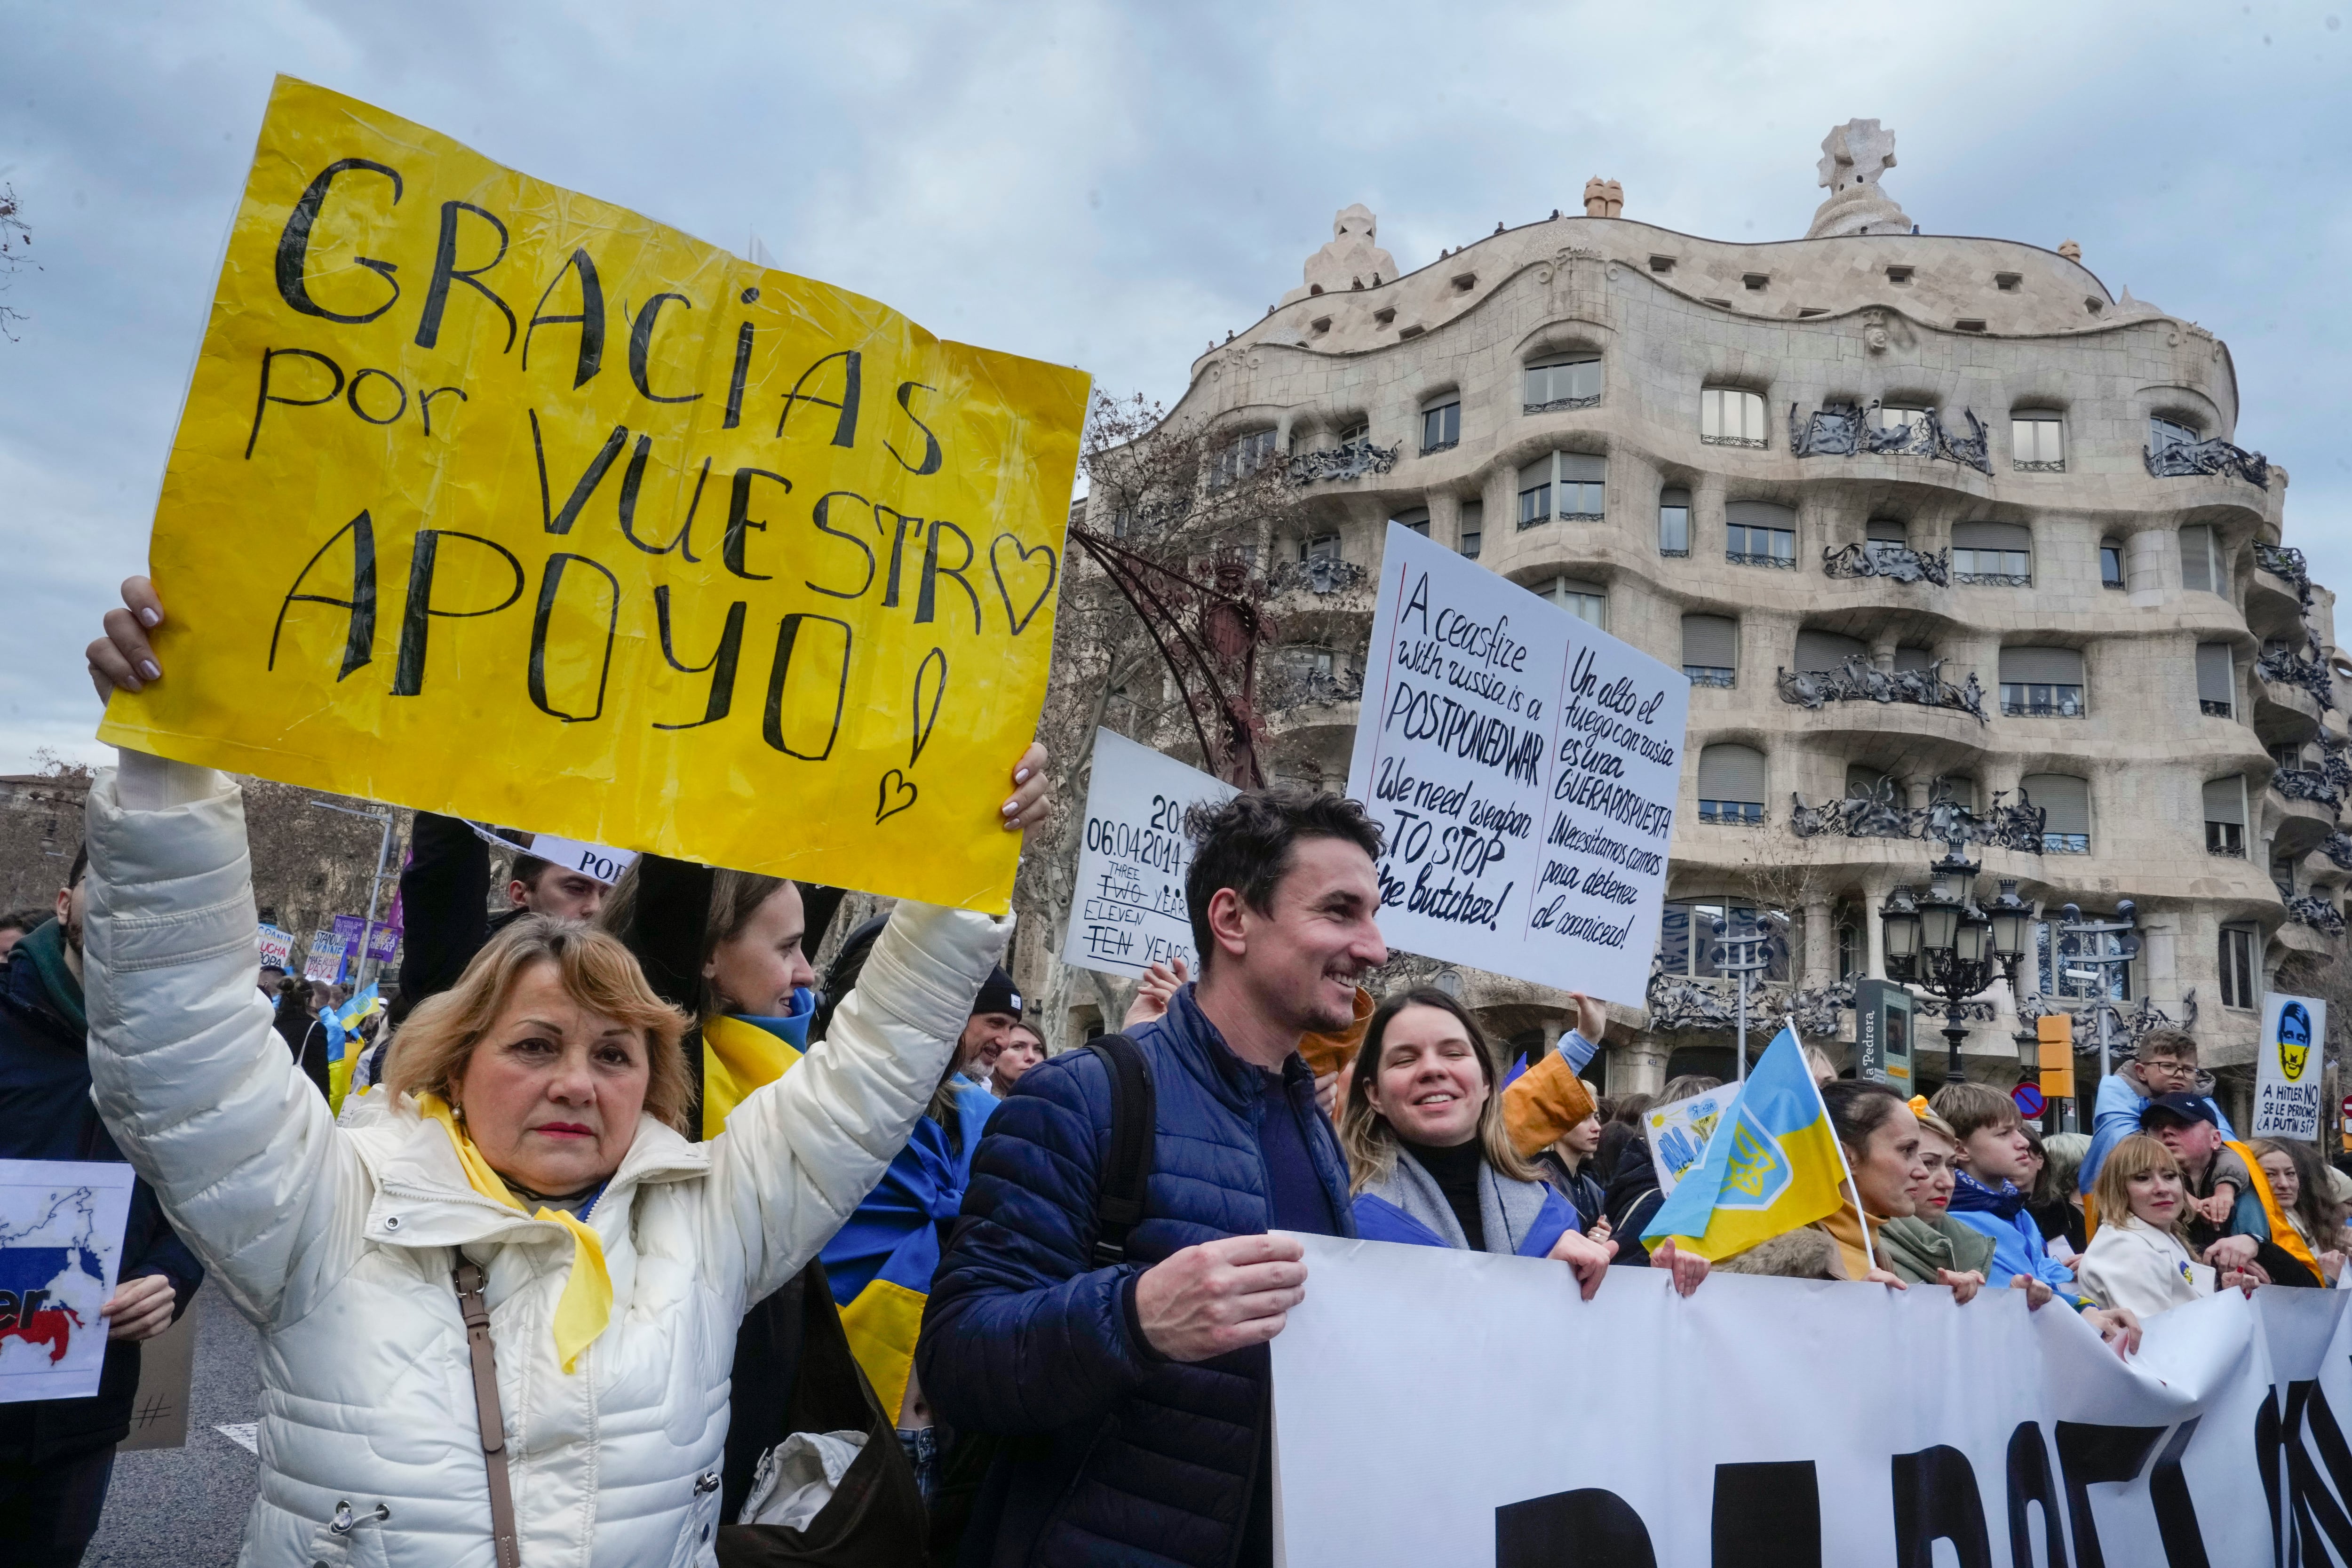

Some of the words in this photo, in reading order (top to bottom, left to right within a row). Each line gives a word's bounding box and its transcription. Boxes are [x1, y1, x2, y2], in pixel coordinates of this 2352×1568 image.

[1401, 572, 1427, 636] A
[1398, 640, 1443, 679] with
[1449, 661, 1506, 704] russia
[1507, 685, 1524, 712] is
[1527, 699, 1542, 721] a
[1570, 645, 1597, 697] Un
[1598, 677, 1637, 716] alto
[1637, 691, 1664, 724] el
[1385, 682, 1509, 767] POSTPONED
[1505, 726, 1543, 788] WAR
[1565, 694, 1613, 748] fuego
[1613, 724, 1640, 752] con
[1560, 738, 1582, 766] es
[1581, 748, 1625, 779] una
[1376, 756, 1415, 802] We
[1414, 780, 1473, 820] need
[1608, 785, 1672, 840] POSPUESTA
[1388, 809, 1432, 864] TO
[1431, 826, 1505, 878] STOP
[1626, 847, 1662, 876] armas
[1108, 861, 1140, 881] THREE
[1537, 860, 1581, 894] para
[1582, 867, 1638, 905] detener
[1084, 899, 1147, 926] ELEVEN
[1100, 875, 1141, 903] TWO
[1154, 889, 1190, 918] YEAR
[1375, 860, 1406, 907] he
[1407, 862, 1514, 931] butcher!
[1531, 894, 1566, 930] al
[308, 956, 323, 965] MAKE
[369, 941, 394, 952] RIETAT
[371, 934, 395, 946] PRECA
[1088, 925, 1134, 955] TEN
[1862, 1011, 1875, 1064] Pedrera
[2263, 1084, 2272, 1098] A
[2304, 1083, 2318, 1106] NO
[2263, 1102, 2274, 1114] SE
[2275, 1103, 2285, 1116] LE
